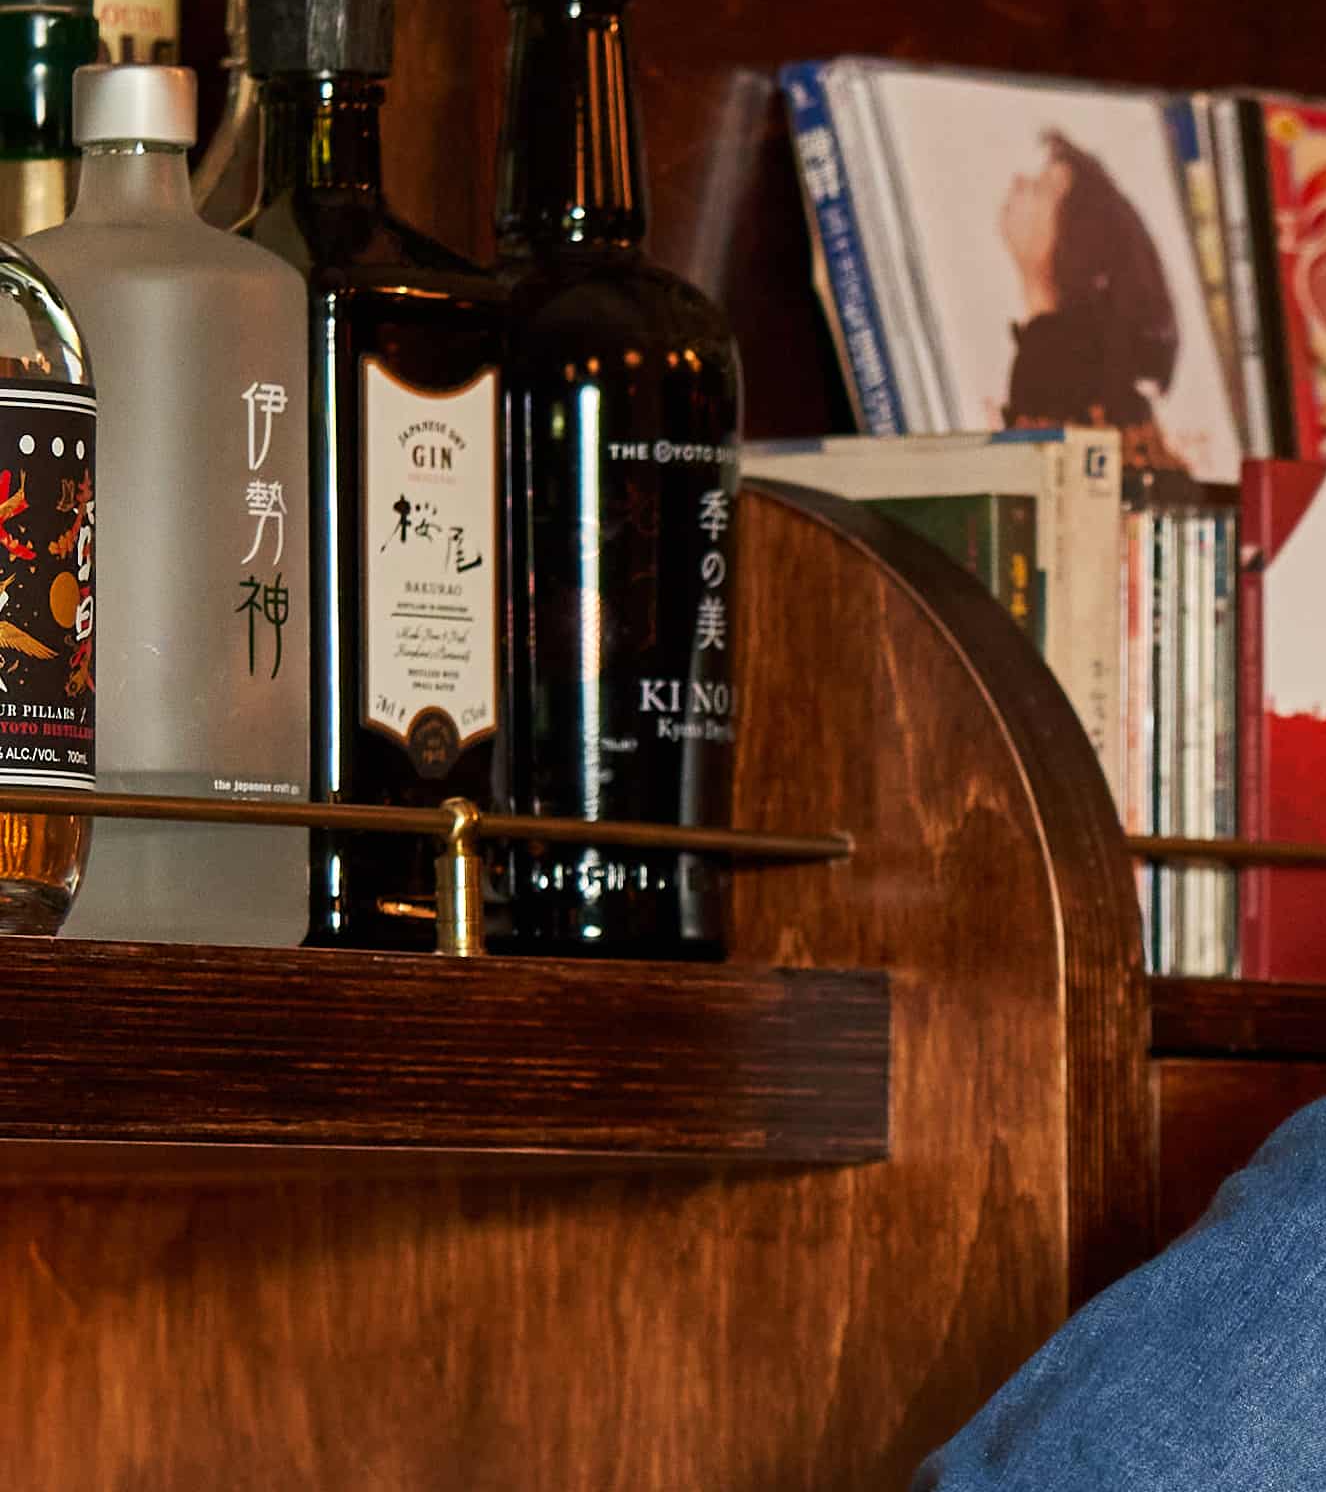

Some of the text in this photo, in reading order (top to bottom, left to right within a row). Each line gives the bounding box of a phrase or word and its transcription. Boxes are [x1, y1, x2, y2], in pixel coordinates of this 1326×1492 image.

[412, 444, 453, 470] GIN
[608, 443, 648, 461] THE
[235, 381, 289, 680] 伊勢神
[380, 493, 482, 574] 桜尾
[699, 489, 729, 650] 季の美
[22, 704, 75, 720] PILLARS
[640, 680, 681, 712] KI
